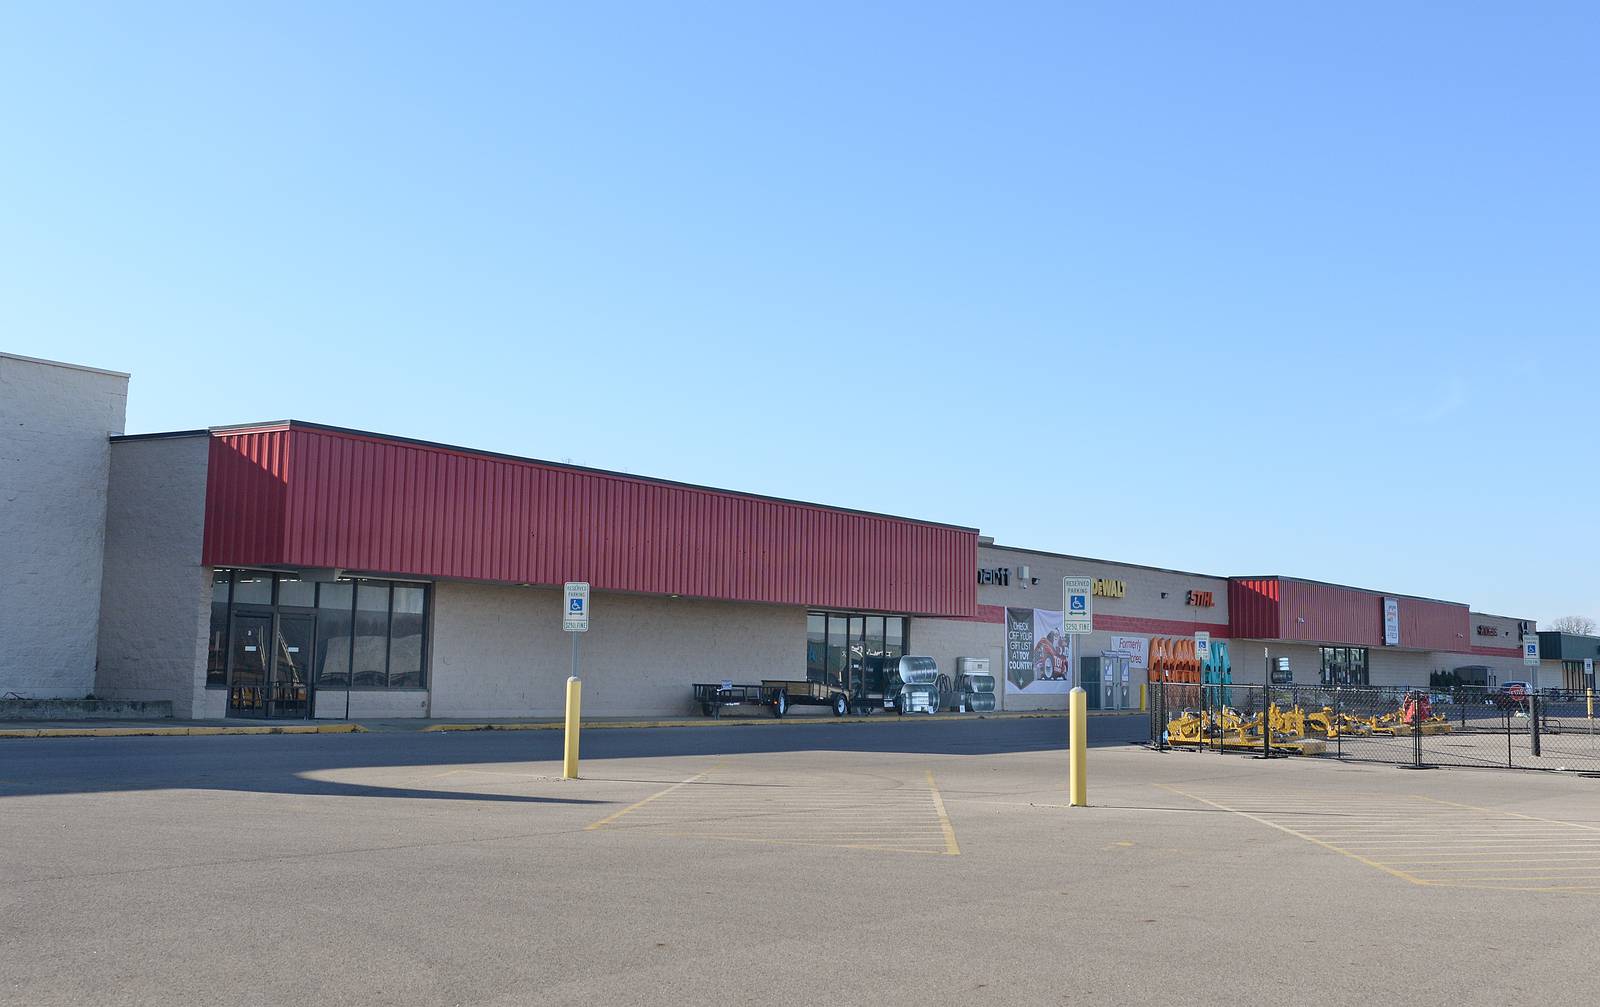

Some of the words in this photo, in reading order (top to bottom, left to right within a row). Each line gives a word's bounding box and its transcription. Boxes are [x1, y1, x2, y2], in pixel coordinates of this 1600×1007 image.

[1013, 622, 1029, 630] CHECK
[1079, 623, 1090, 631] FINE
[1008, 631, 1019, 640] OFF
[1020, 632, 1033, 640] YOUR
[1010, 641, 1021, 650] GIFT
[1021, 641, 1031, 650] LIST
[1119, 637, 1142, 652] Formerly
[1012, 651, 1019, 659] AT
[1019, 651, 1030, 660] TOY
[1008, 661, 1033, 670] COUNTRY
